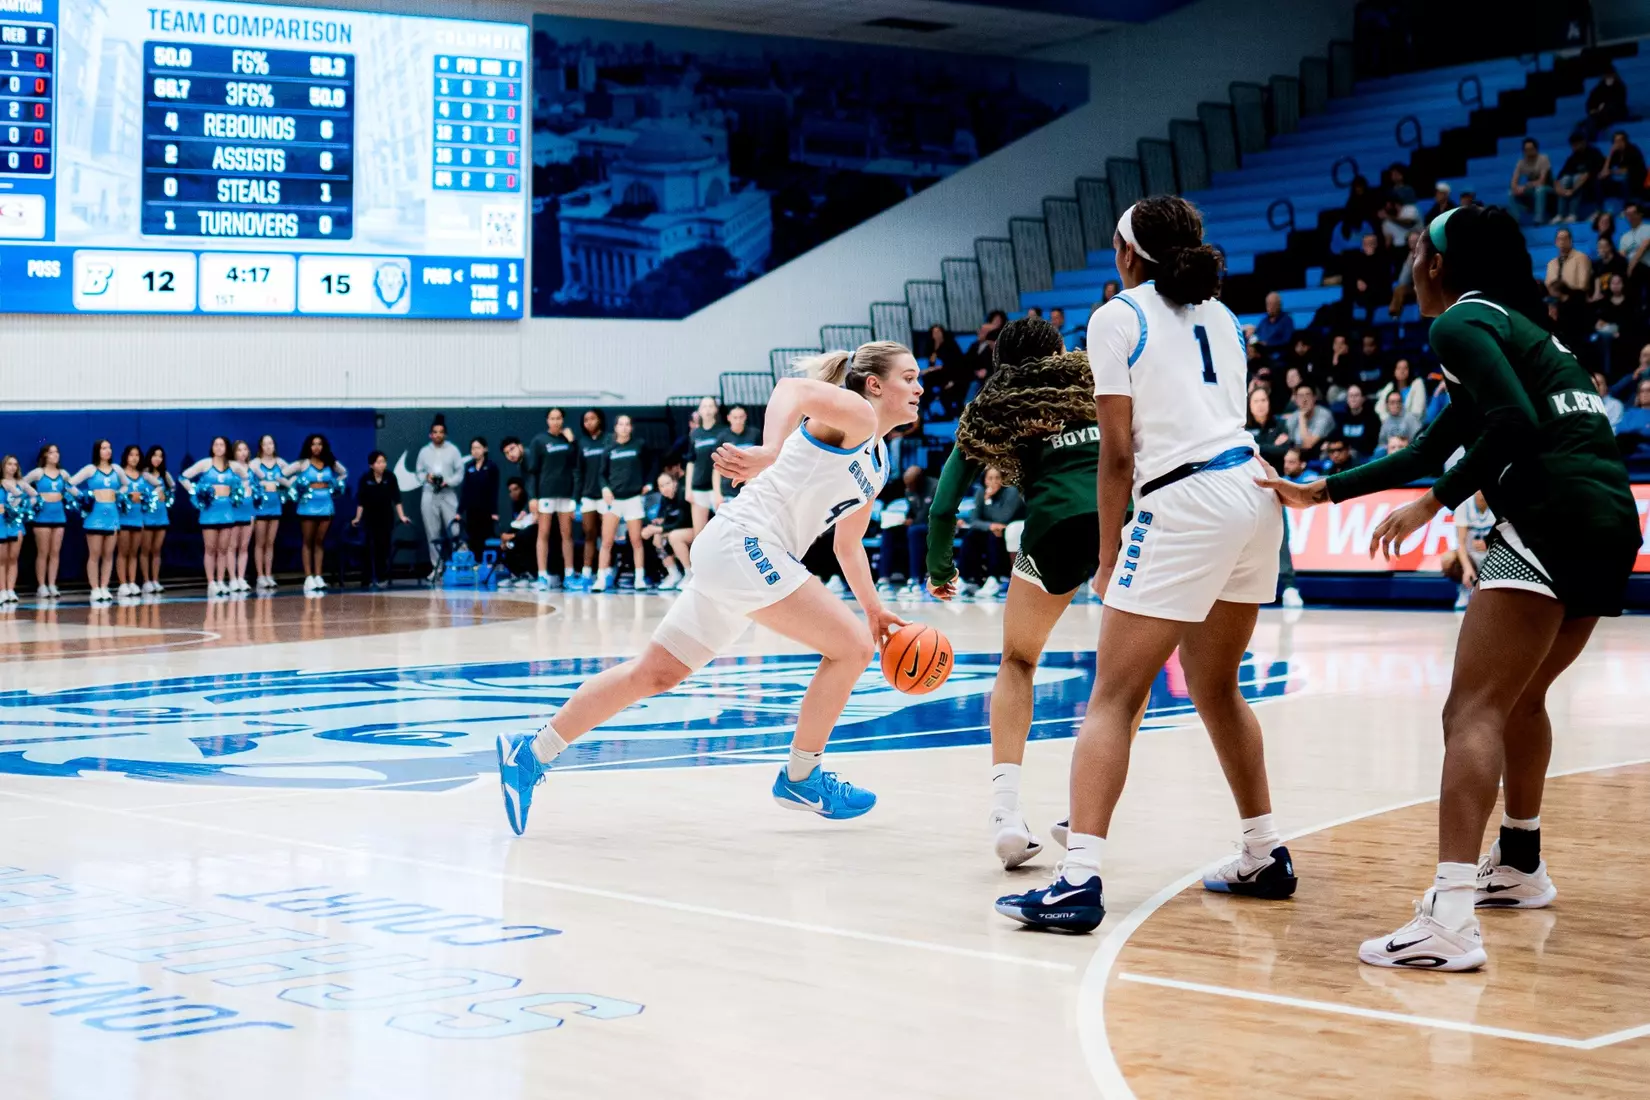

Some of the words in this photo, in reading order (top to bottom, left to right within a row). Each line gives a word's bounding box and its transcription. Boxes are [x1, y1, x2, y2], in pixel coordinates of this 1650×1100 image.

[148, 8, 205, 34] TEAM
[213, 15, 352, 43] COMPARISON
[11, 51, 19, 67] 1
[35, 53, 45, 68] 0
[154, 46, 192, 67] 50.0
[232, 50, 269, 75] FG%
[9, 76, 20, 92] 0
[34, 78, 45, 94] 0
[226, 82, 274, 108] 3FG%
[309, 87, 345, 108] 50.0
[9, 102, 19, 118] 2
[34, 103, 44, 119] 0
[8, 127, 19, 143] 0
[34, 128, 44, 144] 0
[165, 112, 178, 131] 4
[204, 113, 295, 139] REBOUNDS
[8, 152, 19, 168] 0
[34, 154, 43, 168] 0
[165, 144, 178, 164] 2
[212, 146, 285, 172] ASSISTS
[164, 177, 177, 197] 0
[217, 178, 280, 204] STEALS
[320, 183, 331, 203] 1
[164, 210, 176, 230] 1
[198, 210, 298, 237] TURNOVERS
[319, 215, 332, 235] 0
[27, 259, 61, 278] POSS
[142, 270, 175, 292] 12
[226, 267, 270, 283] 4:17
[321, 275, 350, 294] 15
[1193, 324, 1218, 385] 1
[1050, 426, 1101, 449] BOYD
[825, 498, 860, 524] 4
[1118, 510, 1153, 588] LIONS
[923, 651, 948, 687] ELITE
[216, 885, 563, 946] COURT
